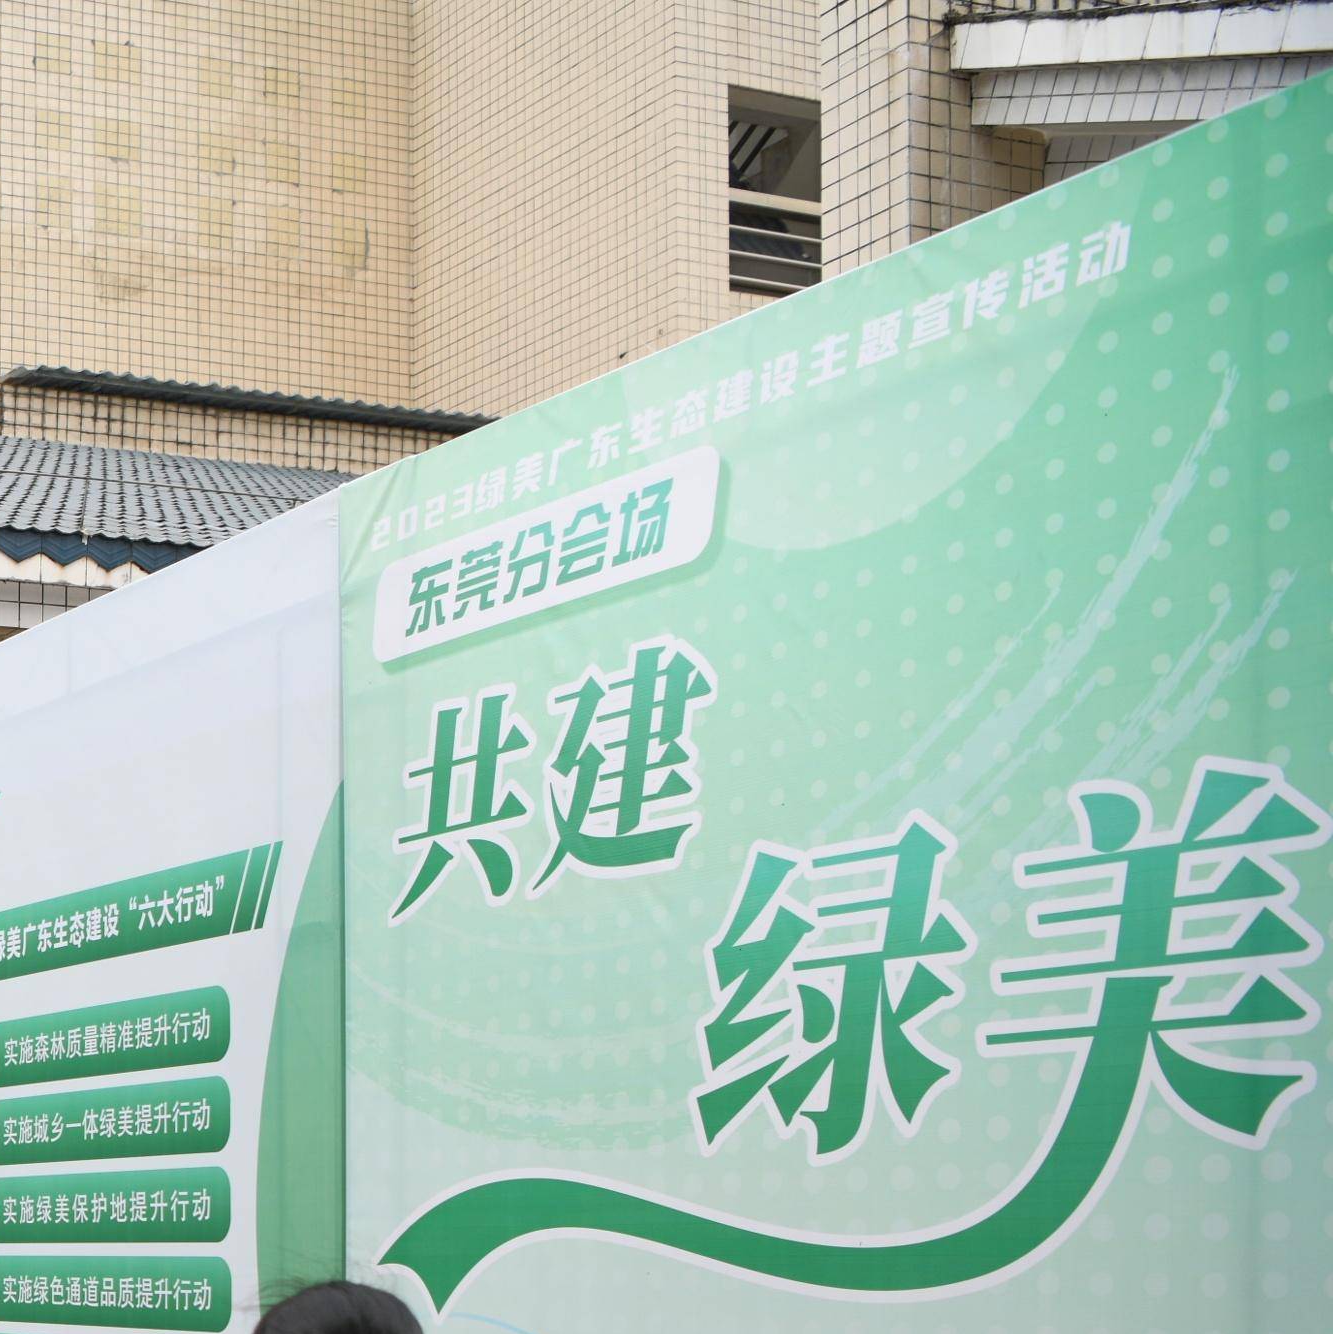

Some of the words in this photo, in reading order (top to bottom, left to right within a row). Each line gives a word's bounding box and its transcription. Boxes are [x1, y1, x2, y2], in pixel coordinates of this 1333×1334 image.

[370, 219, 1133, 551] 2023绿美广东生态建设主题宣传活动
[404, 477, 675, 637] 东莞分会场
[389, 642, 713, 922] 共建
[3, 1007, 212, 1067] 实施森林质量精准提升行动
[2, 1097, 212, 1147] 实施城乡一体绿美提升行动
[2, 1186, 212, 1226] 实施绿美保护地提升行动
[2, 1274, 212, 1313] 实施绿色通道品质提升行动
